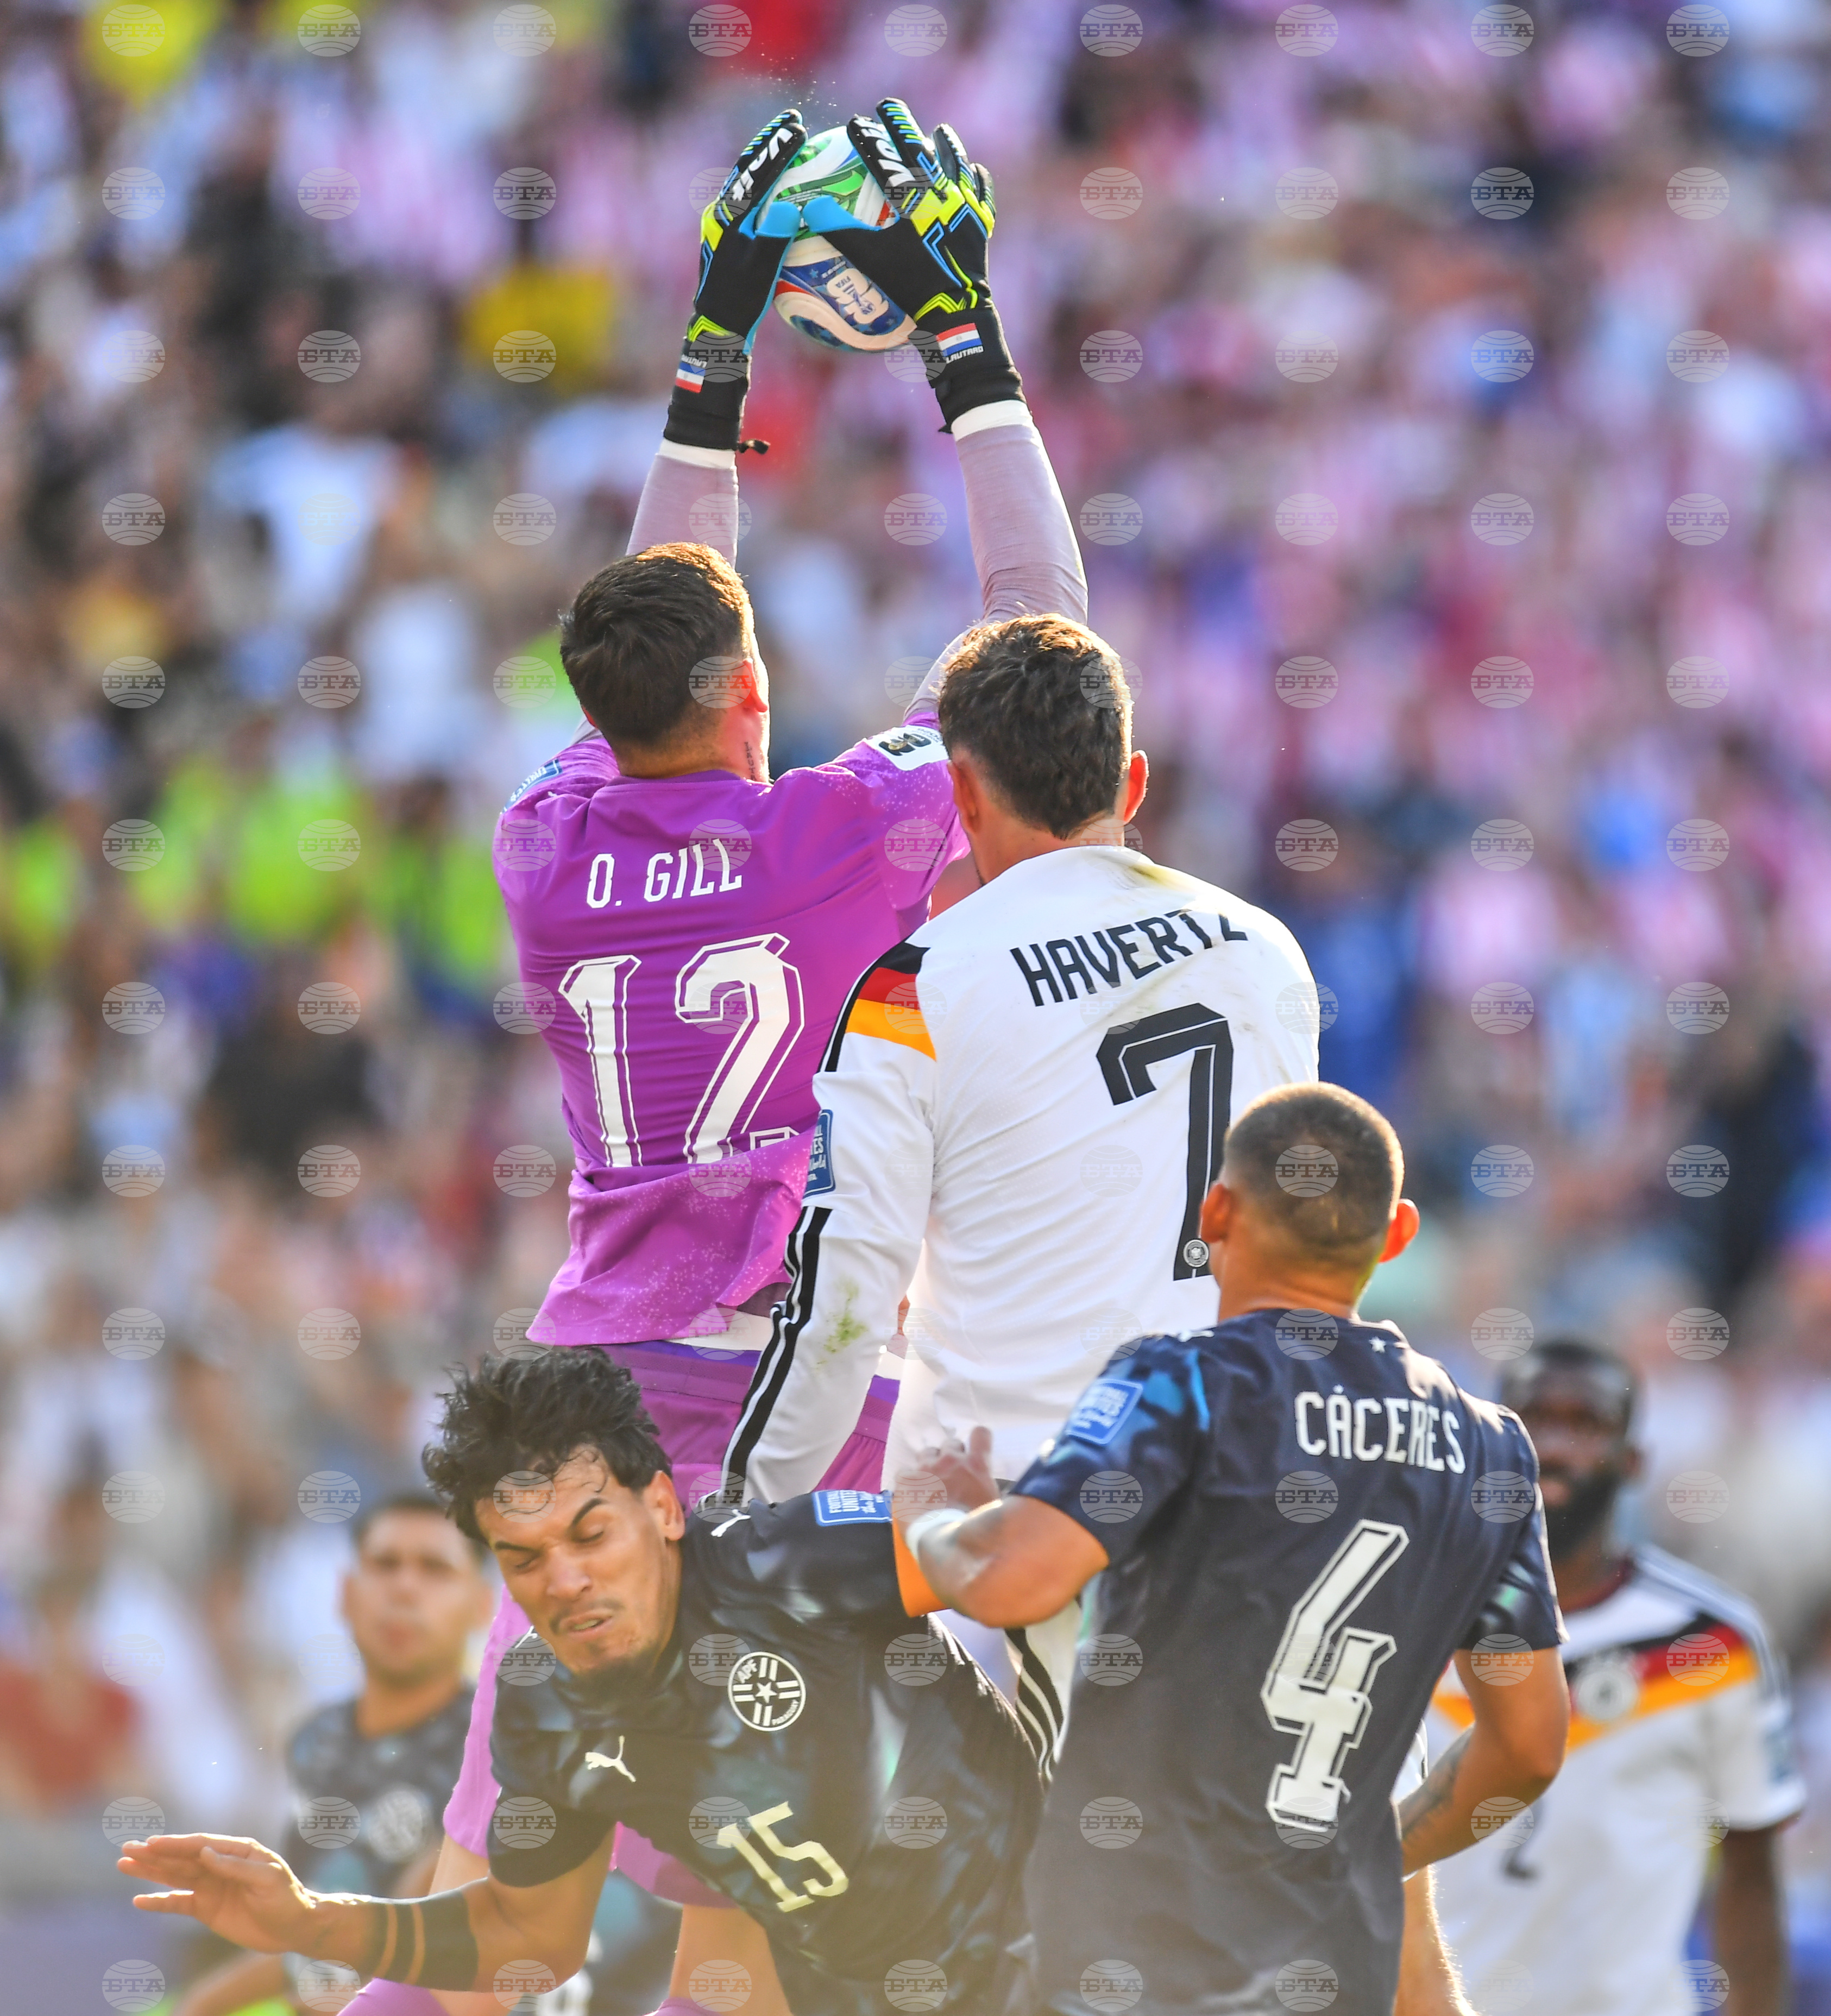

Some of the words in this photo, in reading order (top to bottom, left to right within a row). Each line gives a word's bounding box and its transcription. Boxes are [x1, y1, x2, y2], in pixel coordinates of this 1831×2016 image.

[946, 345, 984, 364] LAUTARO
[586, 853, 623, 909] O.
[643, 838, 743, 903] GILL
[558, 932, 806, 1169] 12
[1096, 1003, 1234, 1281] 7
[1294, 1384, 1467, 1475] CÁCERES
[737, 1659, 758, 1684] APF
[1260, 1519, 1410, 1832] 4
[717, 1800, 851, 1913] 15
